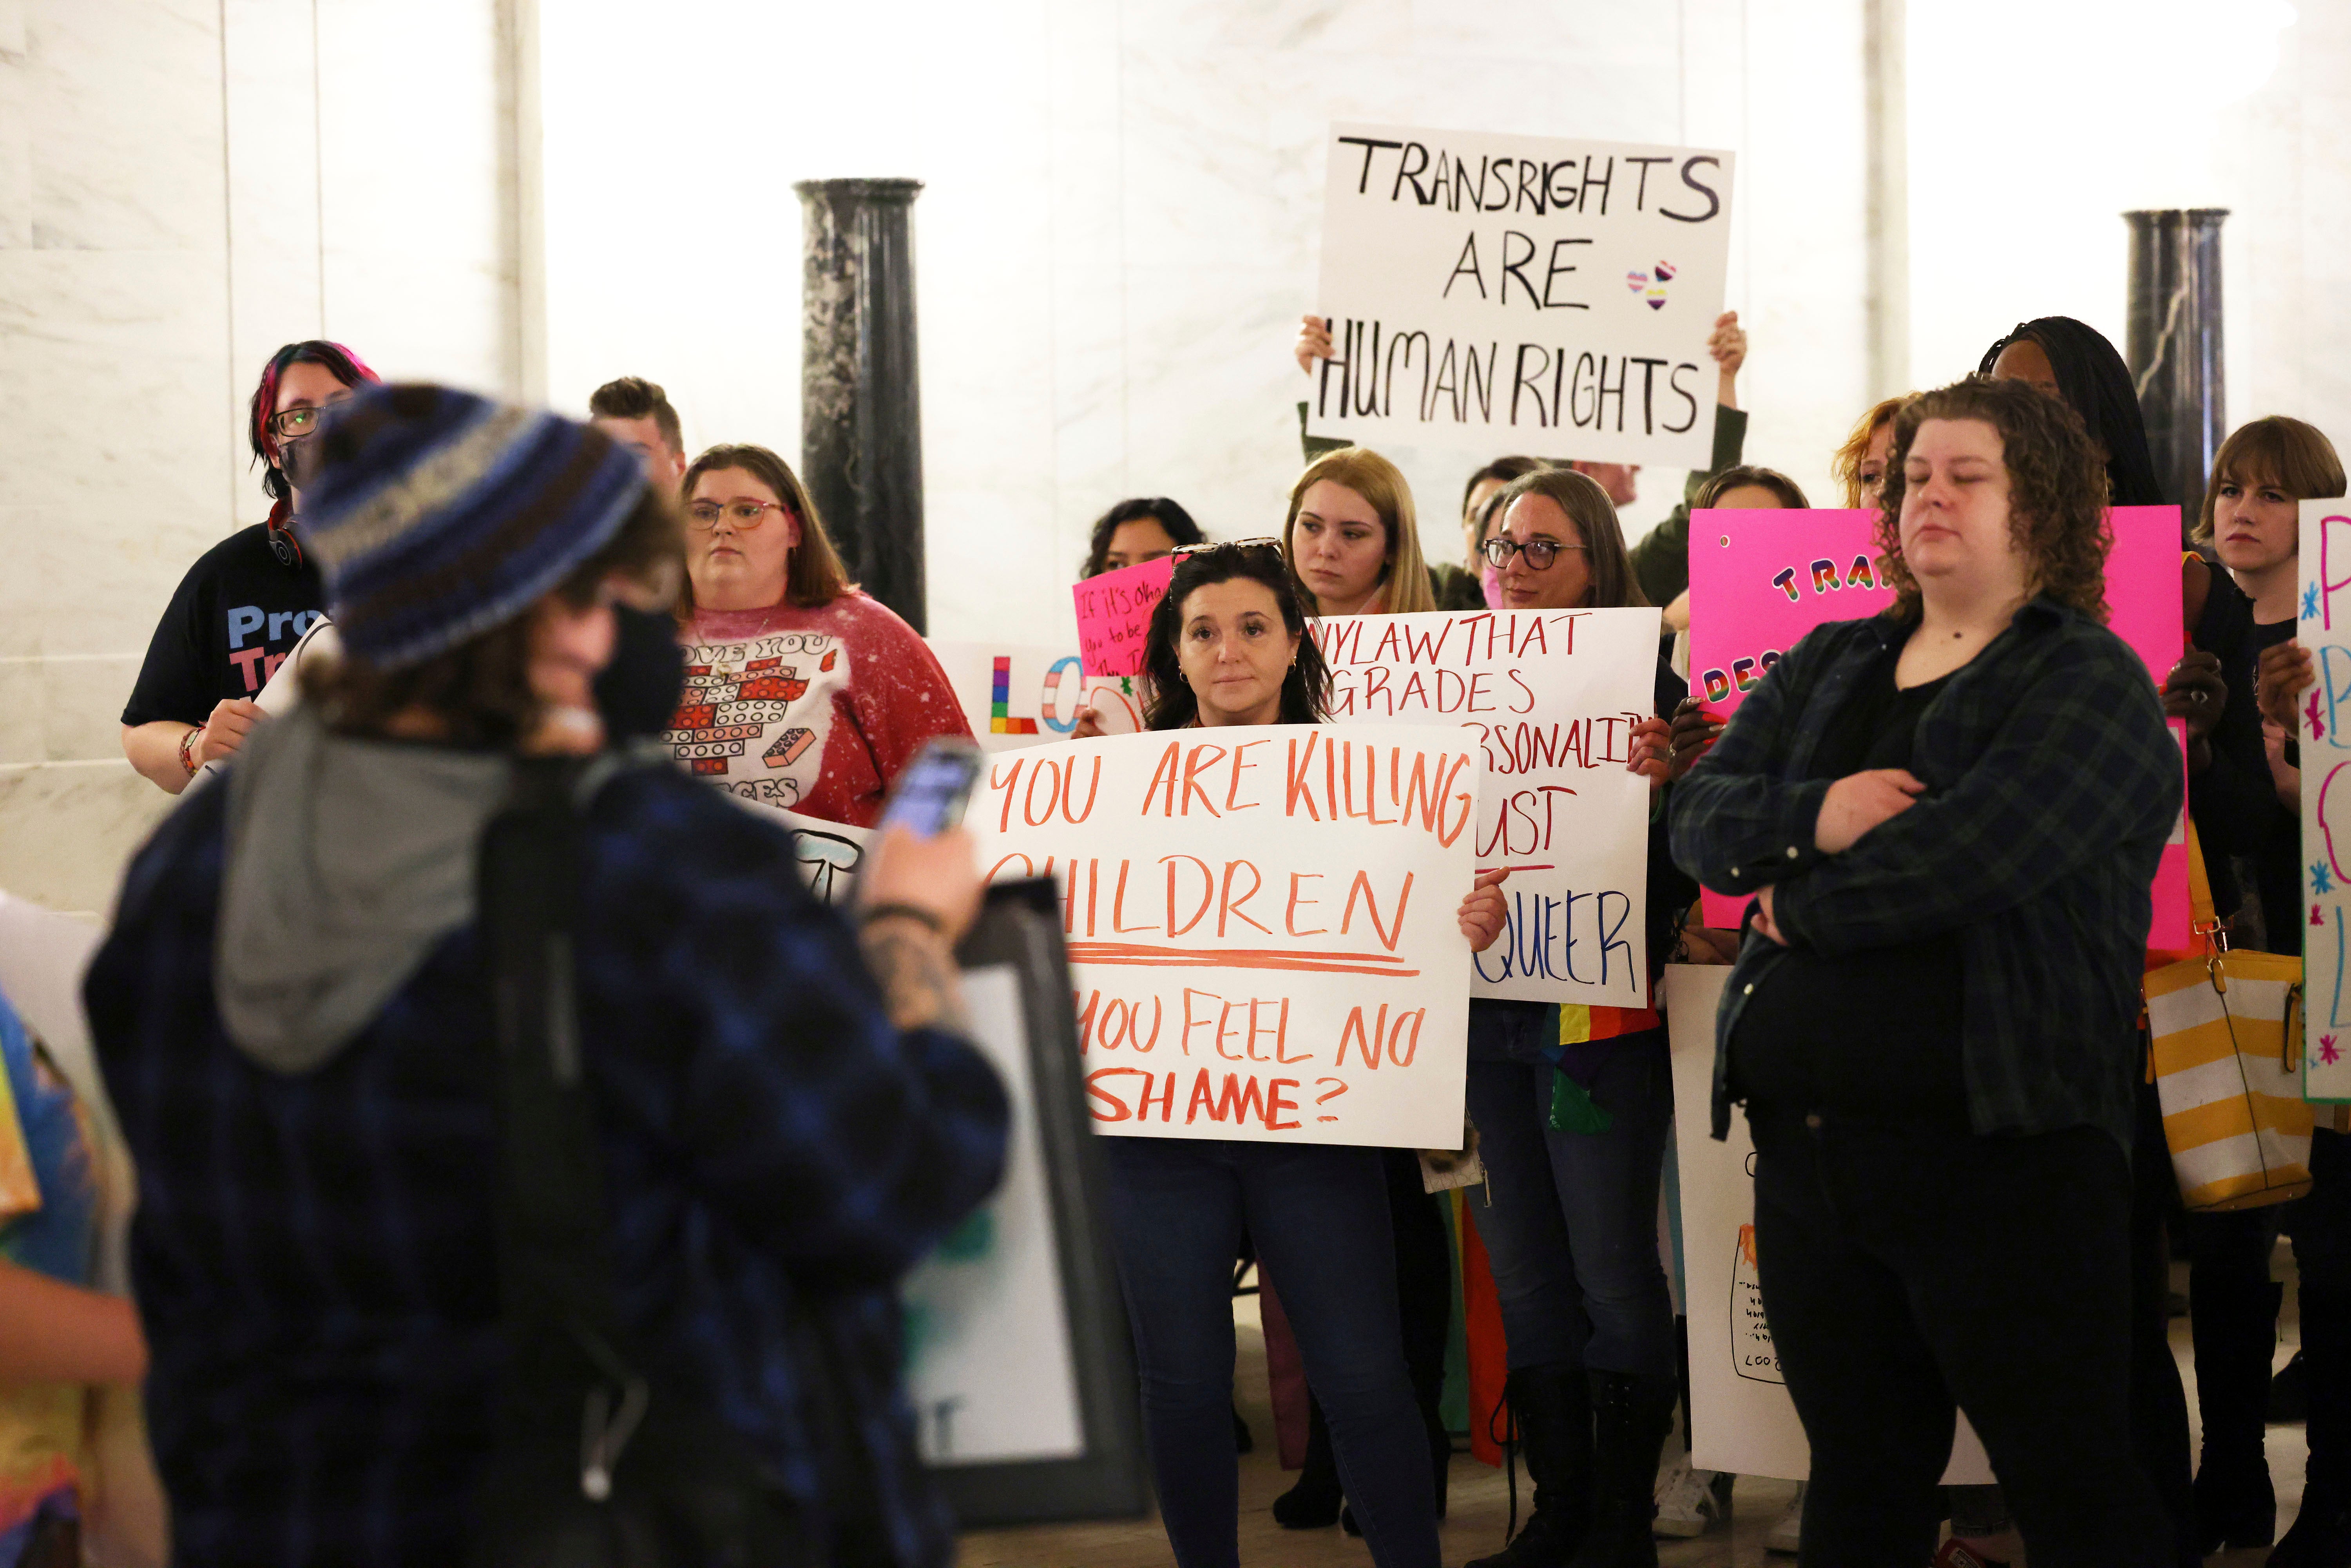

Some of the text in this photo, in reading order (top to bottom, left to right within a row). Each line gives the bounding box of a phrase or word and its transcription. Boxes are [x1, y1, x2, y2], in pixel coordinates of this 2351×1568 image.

[1442, 230, 1594, 311] ARE
[1319, 318, 1699, 435] HUMAN RIGHTS
[1771, 554, 1892, 603] TRA
[755, 634, 833, 658] YOU
[1108, 626, 1123, 643] to
[1125, 621, 1142, 638] be
[1459, 612, 1592, 666] THAT
[716, 777, 799, 808] CES
[990, 730, 1472, 849] YOU ARE KILLING
[1072, 987, 1426, 1070] YOU FEEL NO
[1084, 1066, 1349, 1131] SHAME?
